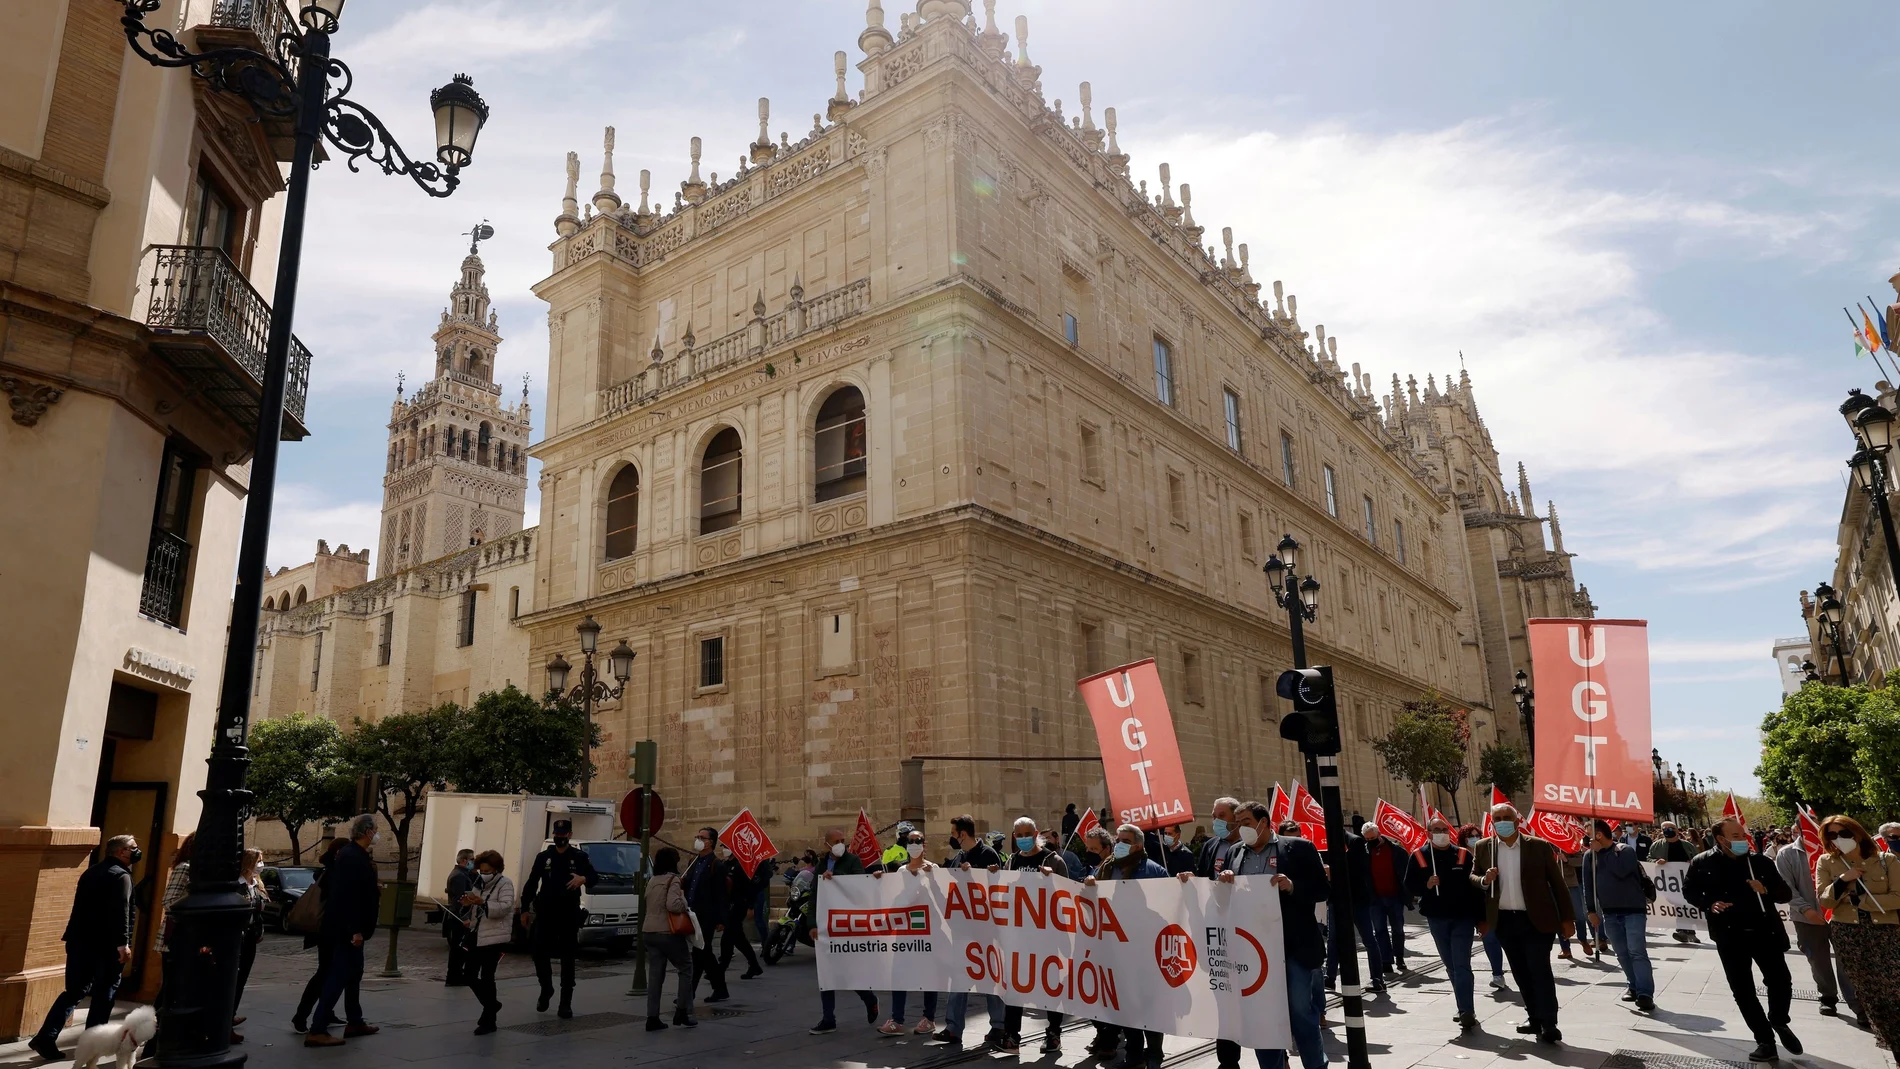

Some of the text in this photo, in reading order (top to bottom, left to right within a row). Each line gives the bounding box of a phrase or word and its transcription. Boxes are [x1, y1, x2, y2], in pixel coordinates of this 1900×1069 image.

[678, 389, 729, 416] MEMORIA
[808, 346, 841, 367] EIVS
[130, 647, 197, 680] STARBUCKS
[1567, 626, 1608, 777] UGT
[1105, 672, 1153, 796] UGT
[1120, 799, 1184, 824] SEVILLA
[1544, 783, 1642, 810] SEVILLA
[1387, 815, 1411, 837] UGT
[831, 911, 909, 932] CCOO
[944, 881, 1129, 943] ABENGOA
[830, 939, 932, 953] industria sevilla
[1161, 934, 1188, 959] UGT
[966, 941, 1120, 1011] SOLUCIÓN
